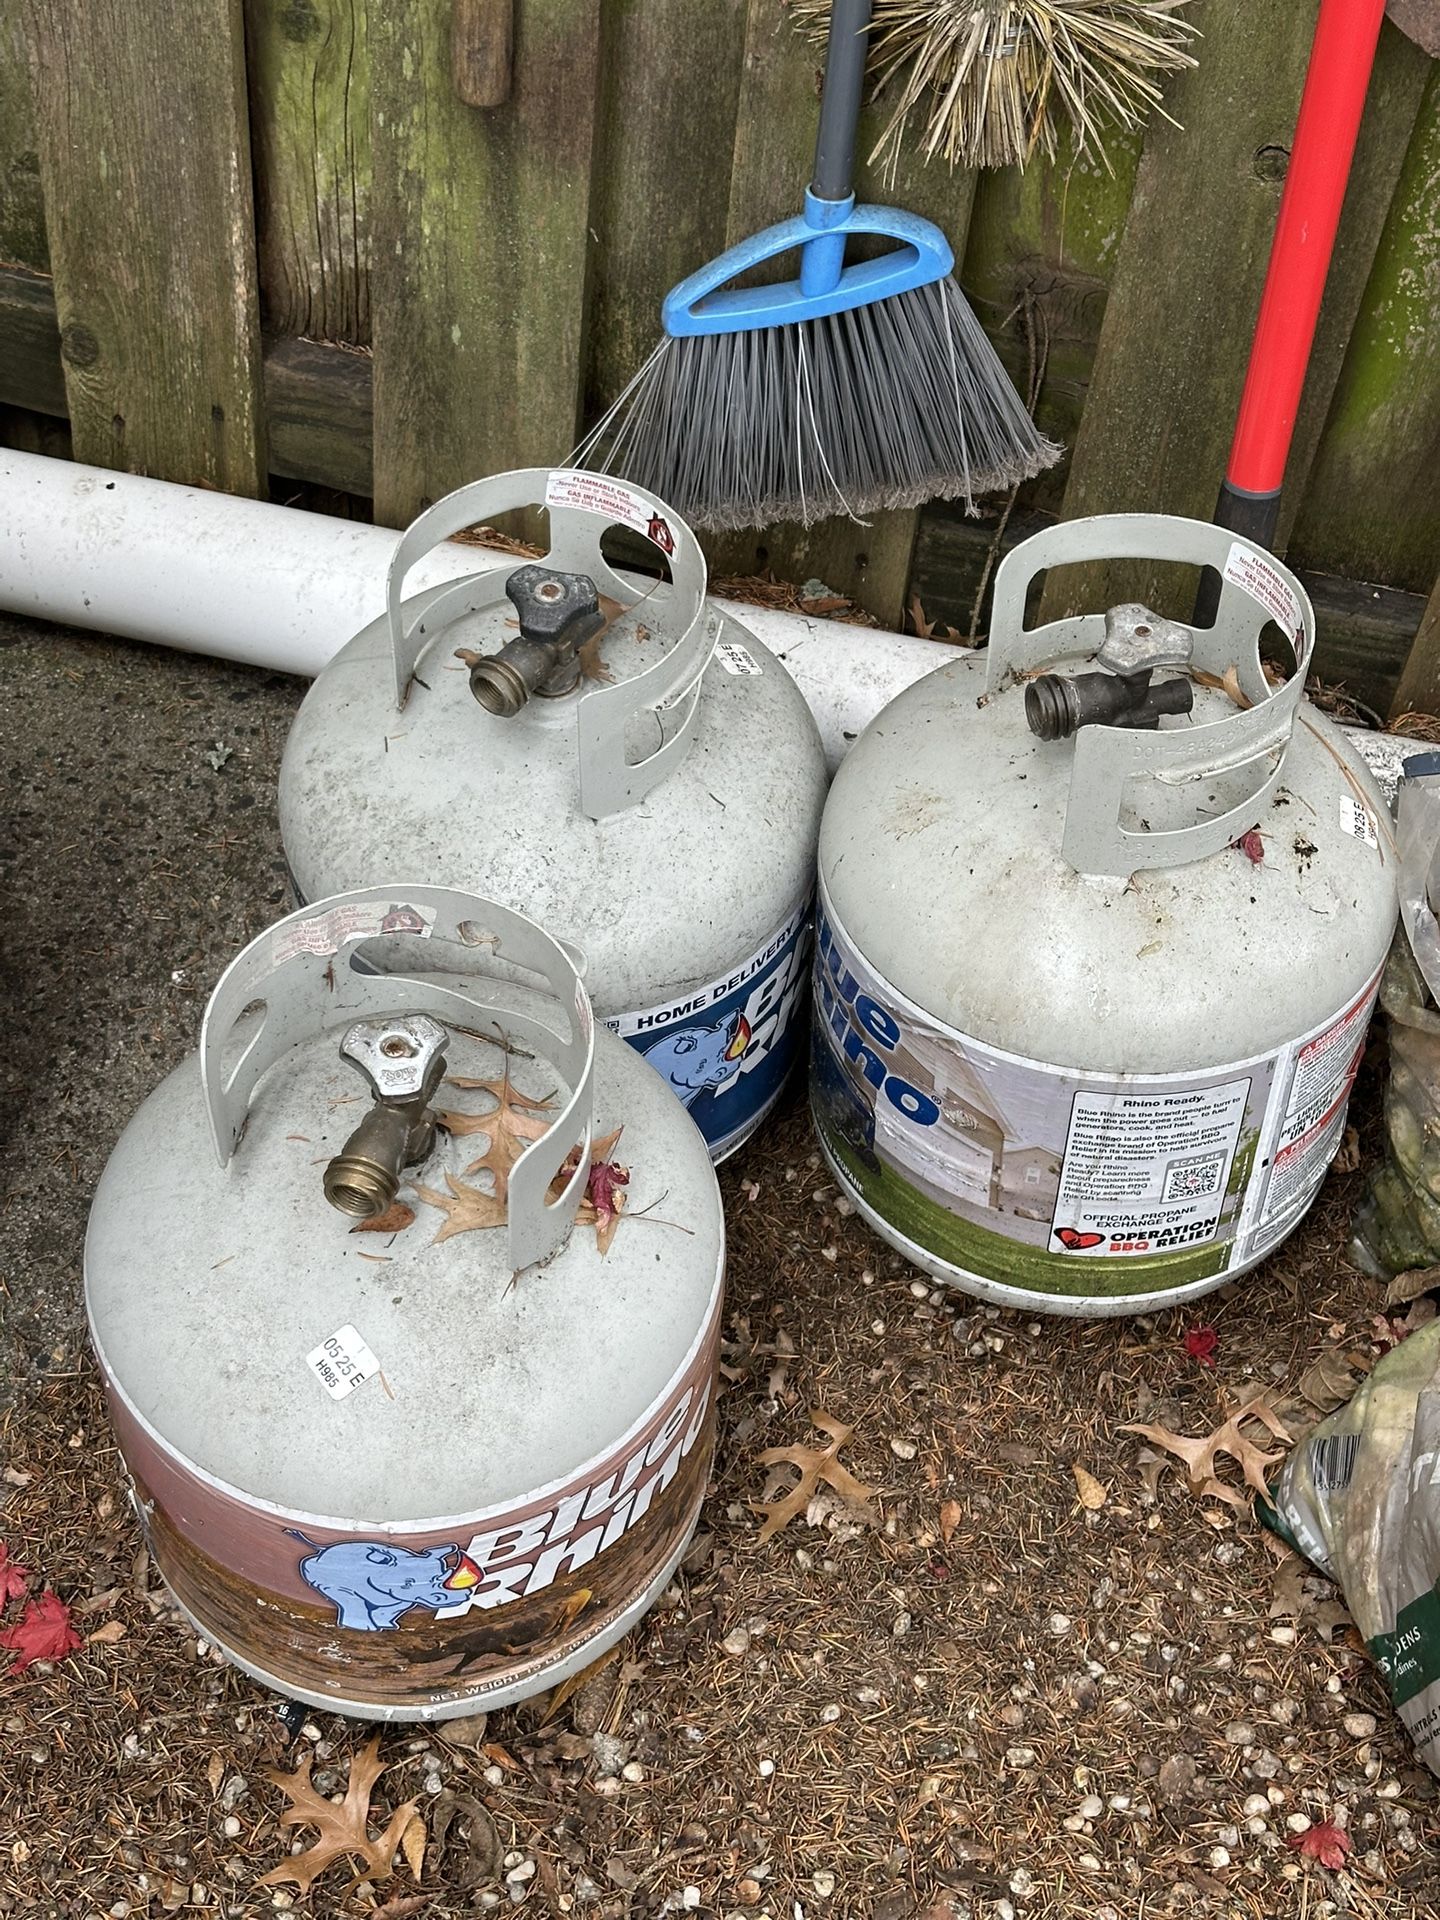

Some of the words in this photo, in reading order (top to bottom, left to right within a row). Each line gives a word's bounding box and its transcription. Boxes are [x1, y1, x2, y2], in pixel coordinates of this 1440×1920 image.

[573, 476, 615, 492] FLAMMABLE
[616, 490, 630, 500] GAS
[568, 490, 582, 498] GAS
[584, 494, 631, 514] INFLAMMABLE
[1252, 558, 1284, 588] FLAMMABLE
[1354, 810, 1366, 826] 25
[1354, 824, 1366, 840] 08
[636, 996, 707, 1030] HOME
[712, 920, 795, 1000] DELIVERY
[1078, 1108, 1098, 1116] Blue
[1182, 1105, 1212, 1115] people
[1214, 1100, 1232, 1108] turn
[1123, 1100, 1160, 1108] Rhino
[1164, 1096, 1206, 1106] Ready.
[1149, 1117, 1172, 1125] goes
[1212, 1106, 1228, 1115] fuel
[1075, 1122, 1126, 1131] generators,
[1170, 1130, 1200, 1139] official
[1200, 1121, 1235, 1135] propane
[1290, 1122, 1306, 1140] UN
[1072, 1140, 1116, 1148] exchange
[1156, 1136, 1199, 1148] Operation
[1200, 1131, 1220, 1140] BBQ
[1072, 1144, 1098, 1152] Relief
[1190, 1136, 1228, 1149] survivors
[1173, 1157, 1204, 1167] SCAN
[1206, 1152, 1221, 1160] ME
[1066, 1174, 1092, 1182] about
[1068, 1167, 1100, 1176] Ready?
[1063, 1192, 1079, 1200] this
[1083, 1214, 1138, 1222] OFFICIAL
[1141, 1206, 1198, 1220] PROPANE
[1096, 1218, 1163, 1228] EXCHANGE
[1110, 1216, 1217, 1242] OPERATION
[1110, 1242, 1150, 1252] BBQ
[1156, 1226, 1214, 1248] RELIEF
[323, 1338, 344, 1358] 05
[335, 1355, 357, 1376] 25
[349, 1372, 366, 1388] E
[315, 1358, 340, 1388] H985
[465, 1386, 694, 1567] Blue
[464, 1673, 520, 1696] WEIGHT
[278, 1704, 290, 1716] 16
